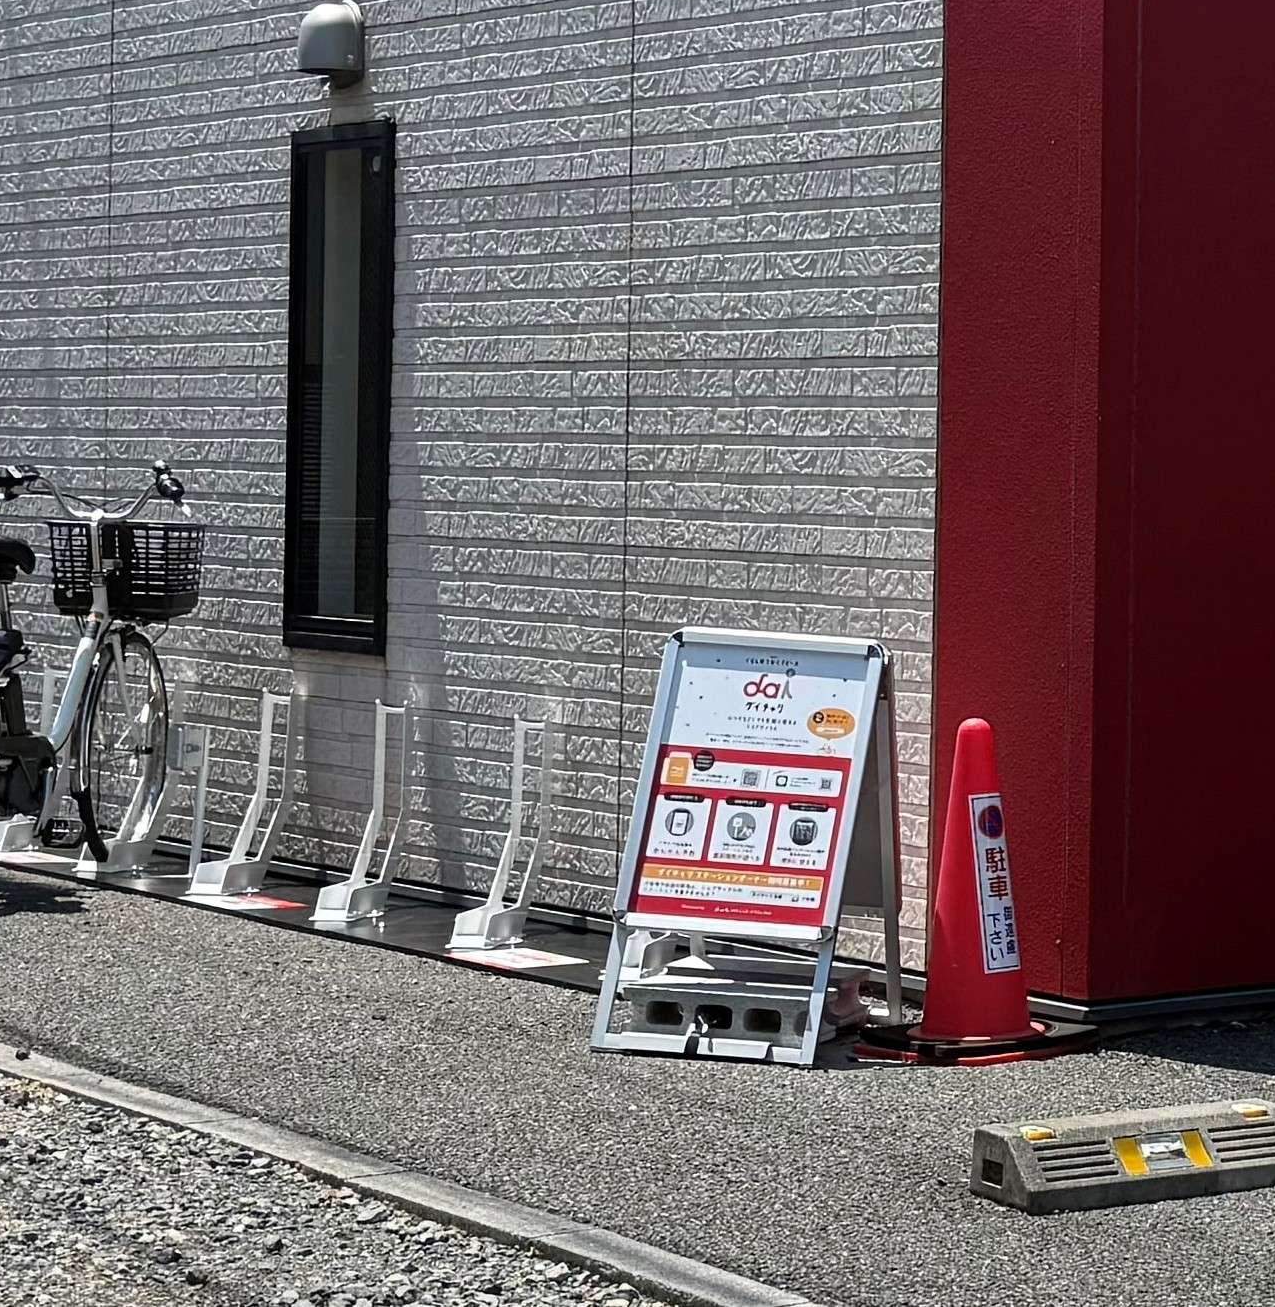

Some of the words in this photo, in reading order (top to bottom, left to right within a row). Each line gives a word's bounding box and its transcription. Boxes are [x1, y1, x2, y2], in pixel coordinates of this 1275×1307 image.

[985, 845, 1009, 901] 駐車
[987, 912, 1005, 962] 下さい
